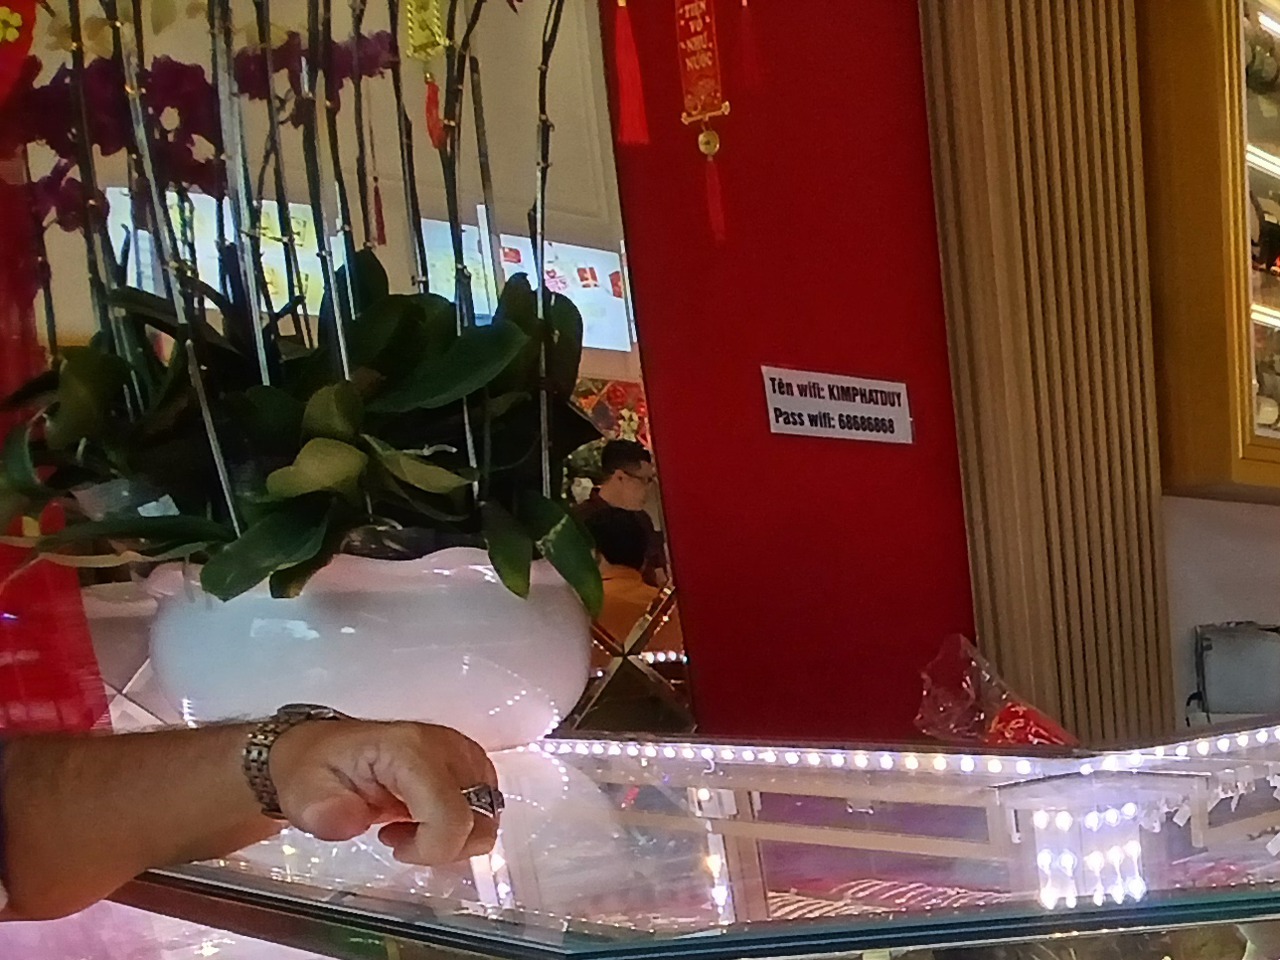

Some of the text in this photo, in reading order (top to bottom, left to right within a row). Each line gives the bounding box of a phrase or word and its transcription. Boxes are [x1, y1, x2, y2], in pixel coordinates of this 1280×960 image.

[769, 377, 794, 397] Tên
[828, 384, 902, 407] KIMPHATDUY
[773, 407, 805, 427] Pass
